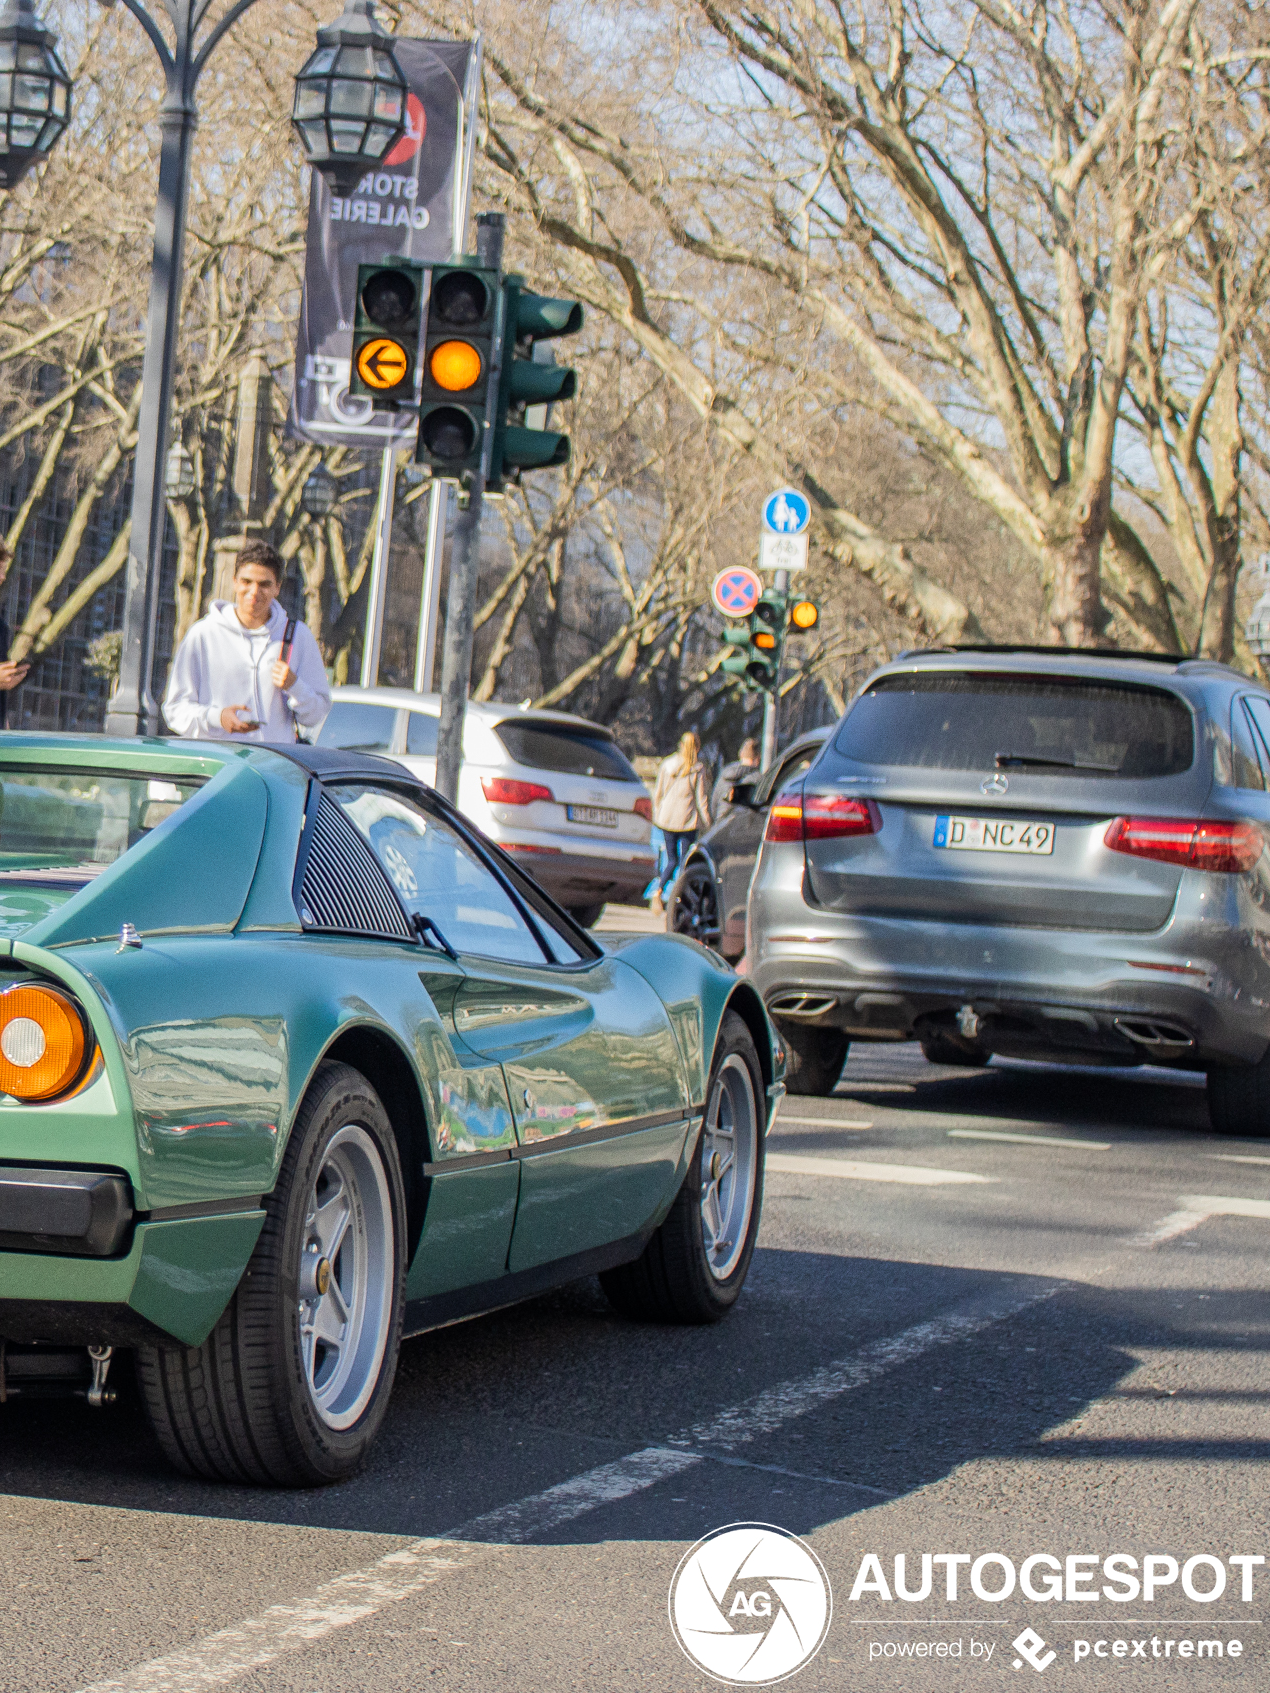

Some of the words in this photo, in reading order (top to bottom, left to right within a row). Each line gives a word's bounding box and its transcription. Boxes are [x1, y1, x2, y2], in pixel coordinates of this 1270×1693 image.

[949, 821, 965, 843] D
[982, 822, 1014, 846] NC
[1018, 826, 1049, 849] 49
